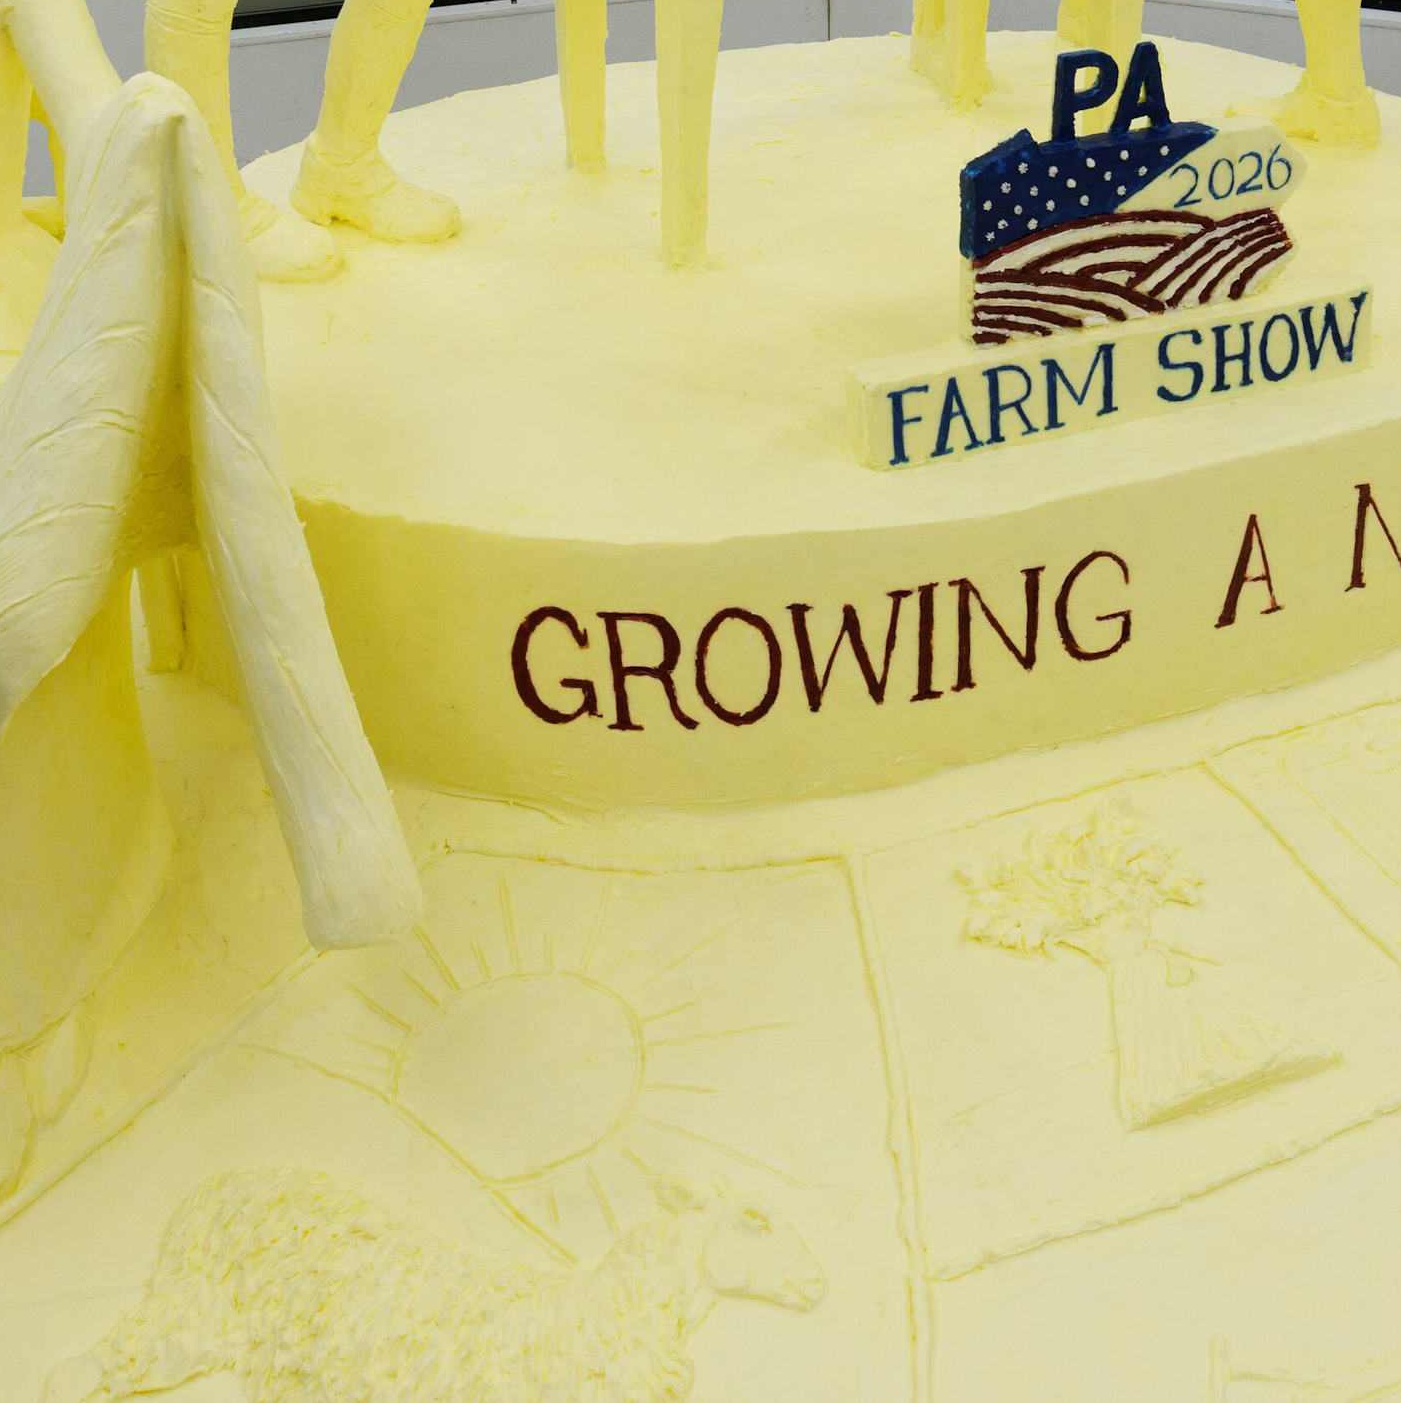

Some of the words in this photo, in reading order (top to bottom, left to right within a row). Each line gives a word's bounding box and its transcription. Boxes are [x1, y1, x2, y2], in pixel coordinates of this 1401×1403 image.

[1050, 41, 1173, 142] PA
[1169, 144, 1292, 208] 2026
[887, 343, 1119, 466] FARM
[1157, 291, 1370, 403] SHOW
[510, 550, 1132, 731] GROWING
[1214, 513, 1285, 630] A
